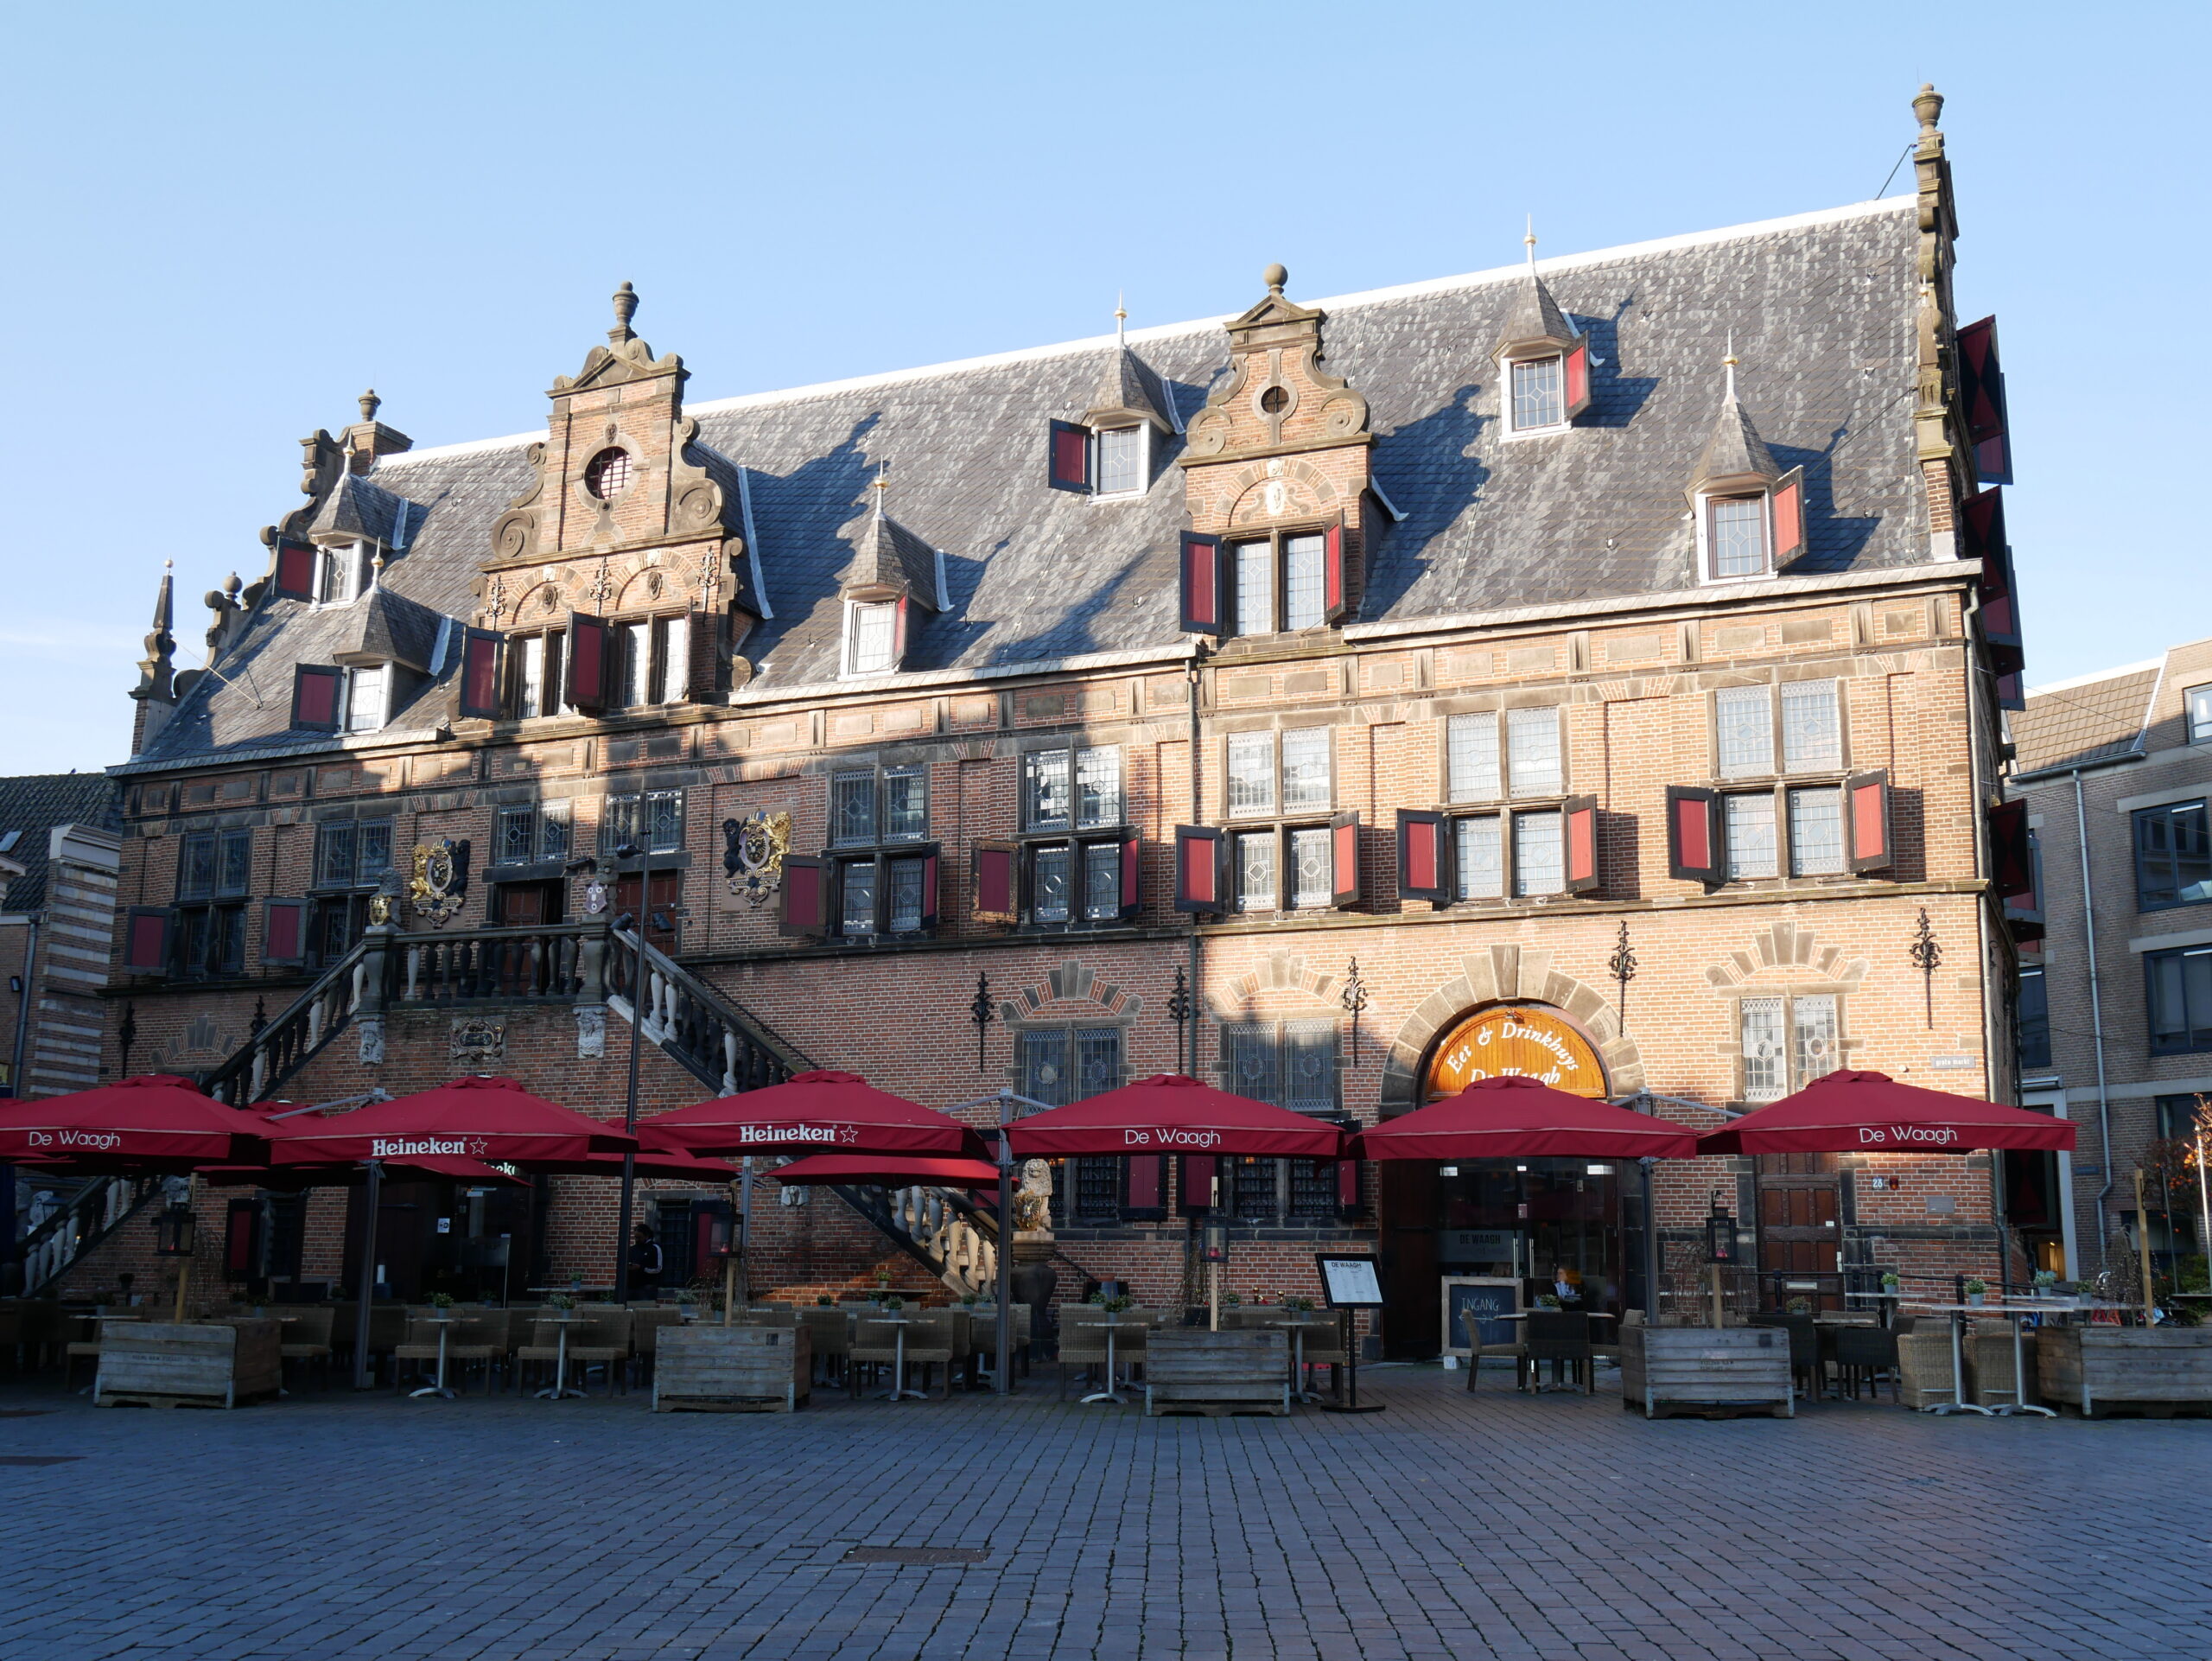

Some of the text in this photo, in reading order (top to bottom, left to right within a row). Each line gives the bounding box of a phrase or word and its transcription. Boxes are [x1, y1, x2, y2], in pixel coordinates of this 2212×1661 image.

[1446, 1022, 1580, 1074] Eet & Drinkhuys
[29, 1130, 121, 1149] De Waagh
[740, 1123, 836, 1142] Heineken
[1125, 1128, 1221, 1148] De Waagh
[1859, 1125, 1958, 1145] De Waagh
[372, 1137, 466, 1156] Heineken
[1459, 1234, 1501, 1244] DE WAAGH
[1461, 1297, 1500, 1312] INGANG
